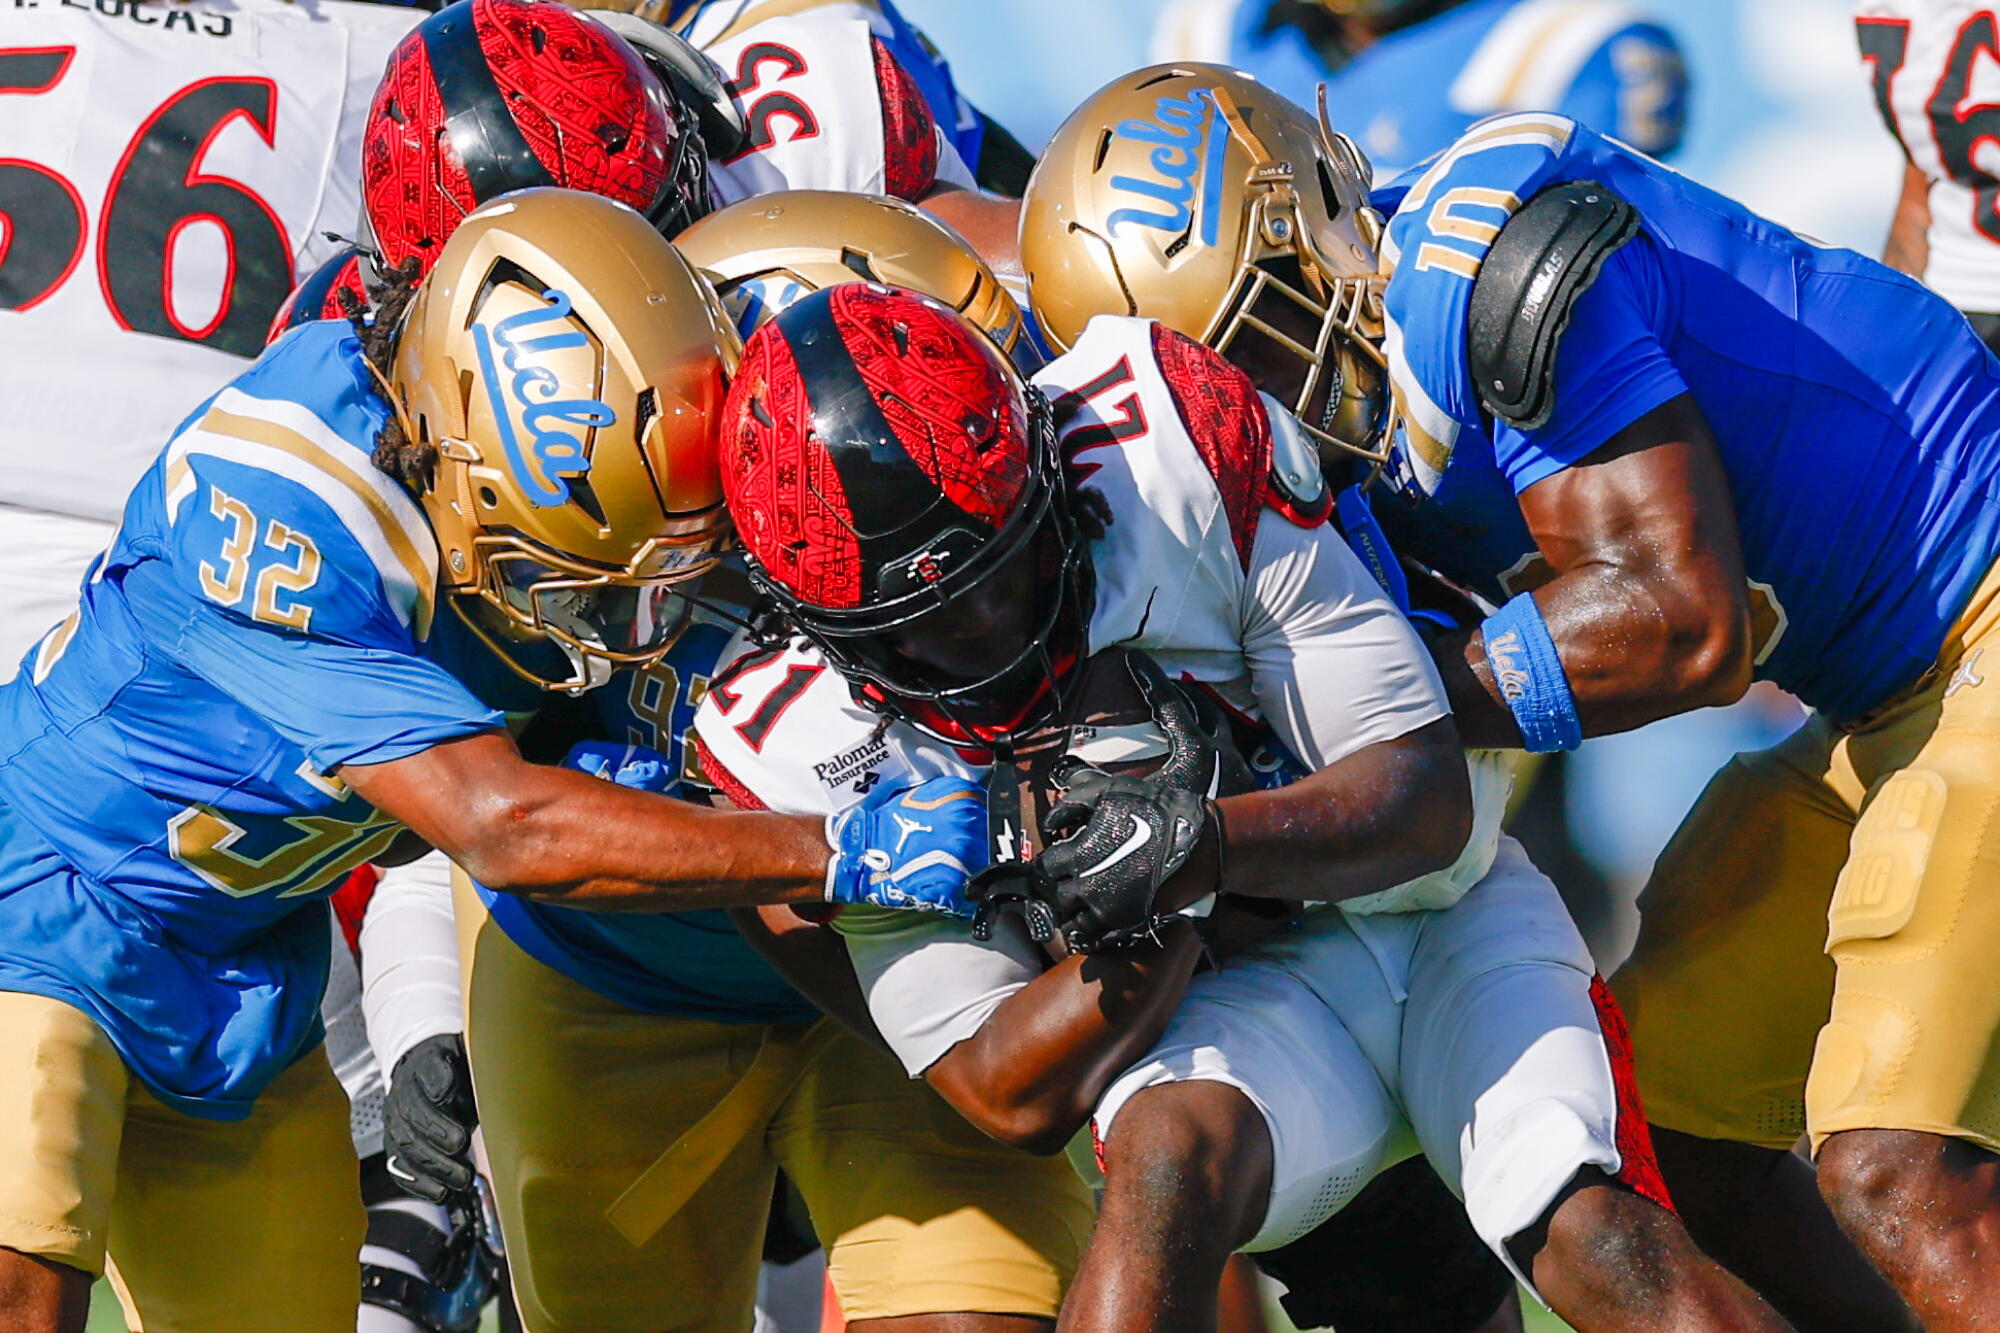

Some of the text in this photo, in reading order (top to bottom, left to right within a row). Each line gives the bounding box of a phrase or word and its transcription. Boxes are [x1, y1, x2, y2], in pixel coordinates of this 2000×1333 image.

[1414, 186, 1523, 280] 10
[472, 289, 616, 507] Ucla
[199, 484, 321, 633] 32
[812, 739, 887, 782] Palomar
[826, 750, 890, 789] Insurance
